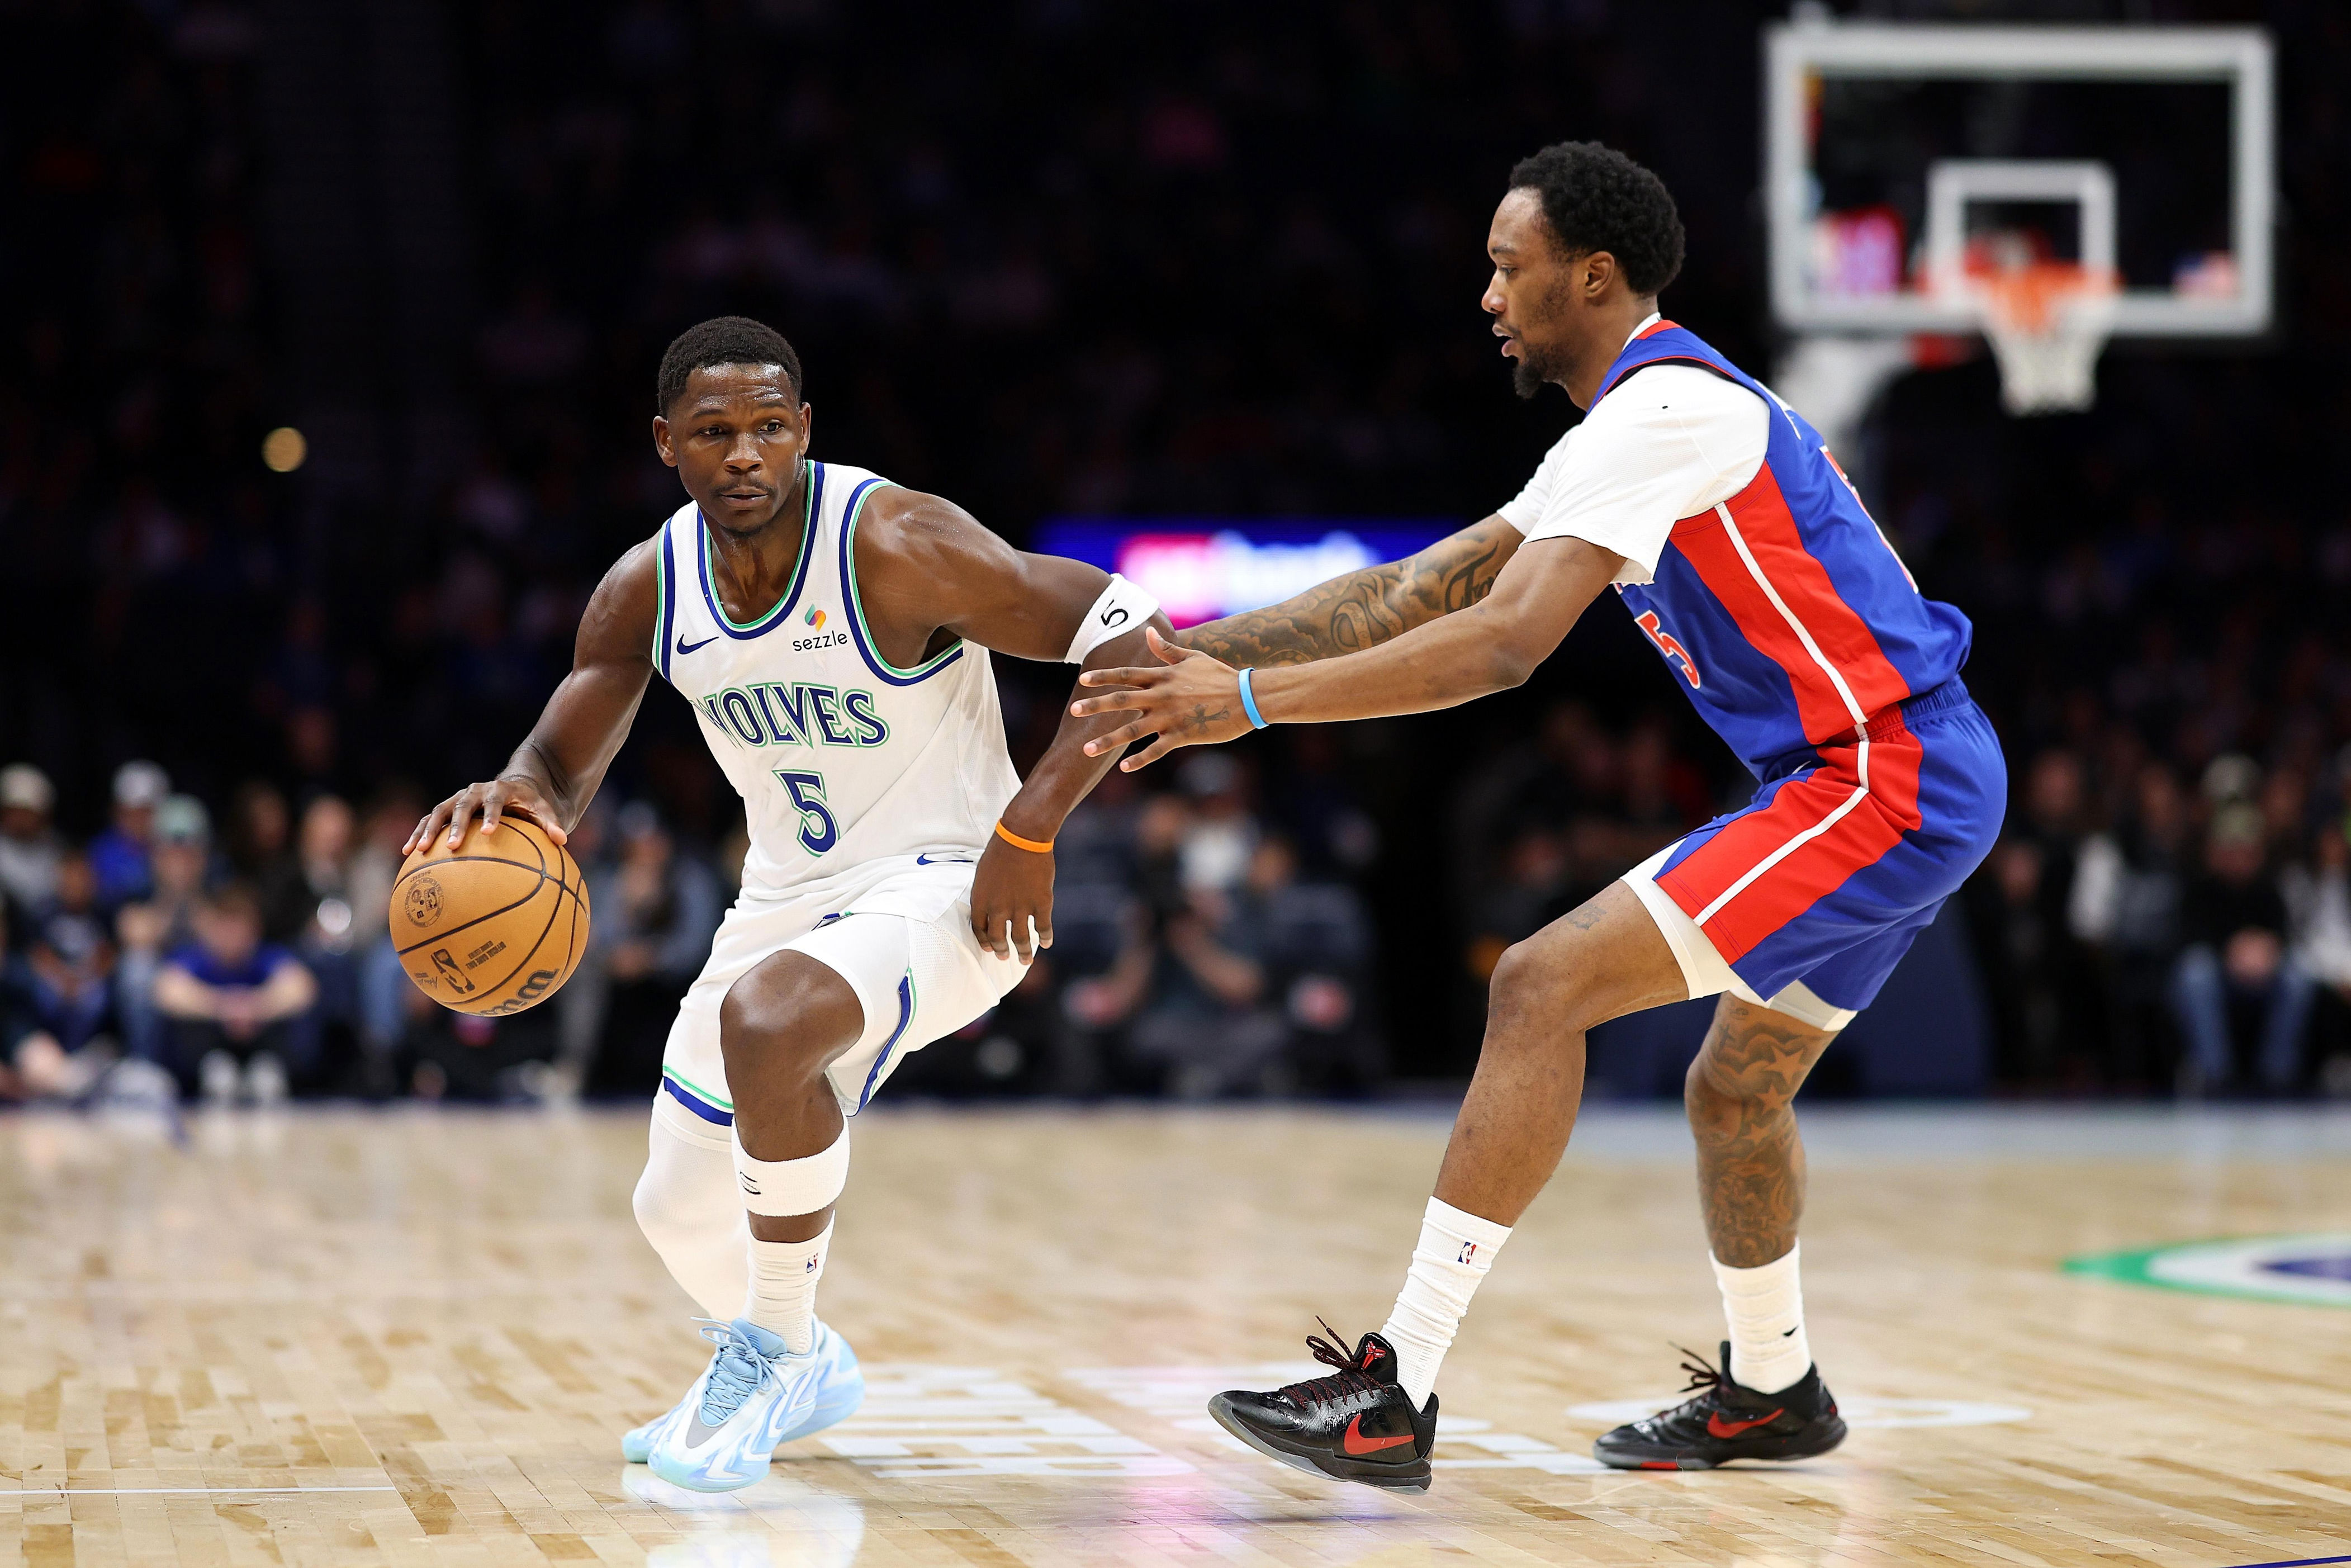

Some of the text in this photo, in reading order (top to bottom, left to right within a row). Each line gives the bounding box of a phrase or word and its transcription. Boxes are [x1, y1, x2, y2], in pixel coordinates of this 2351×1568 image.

[793, 629, 848, 652] sezzle
[1101, 599, 1129, 628] 5
[1634, 610, 1701, 689] 5
[690, 681, 890, 751] WOLVES
[772, 769, 840, 858] 5
